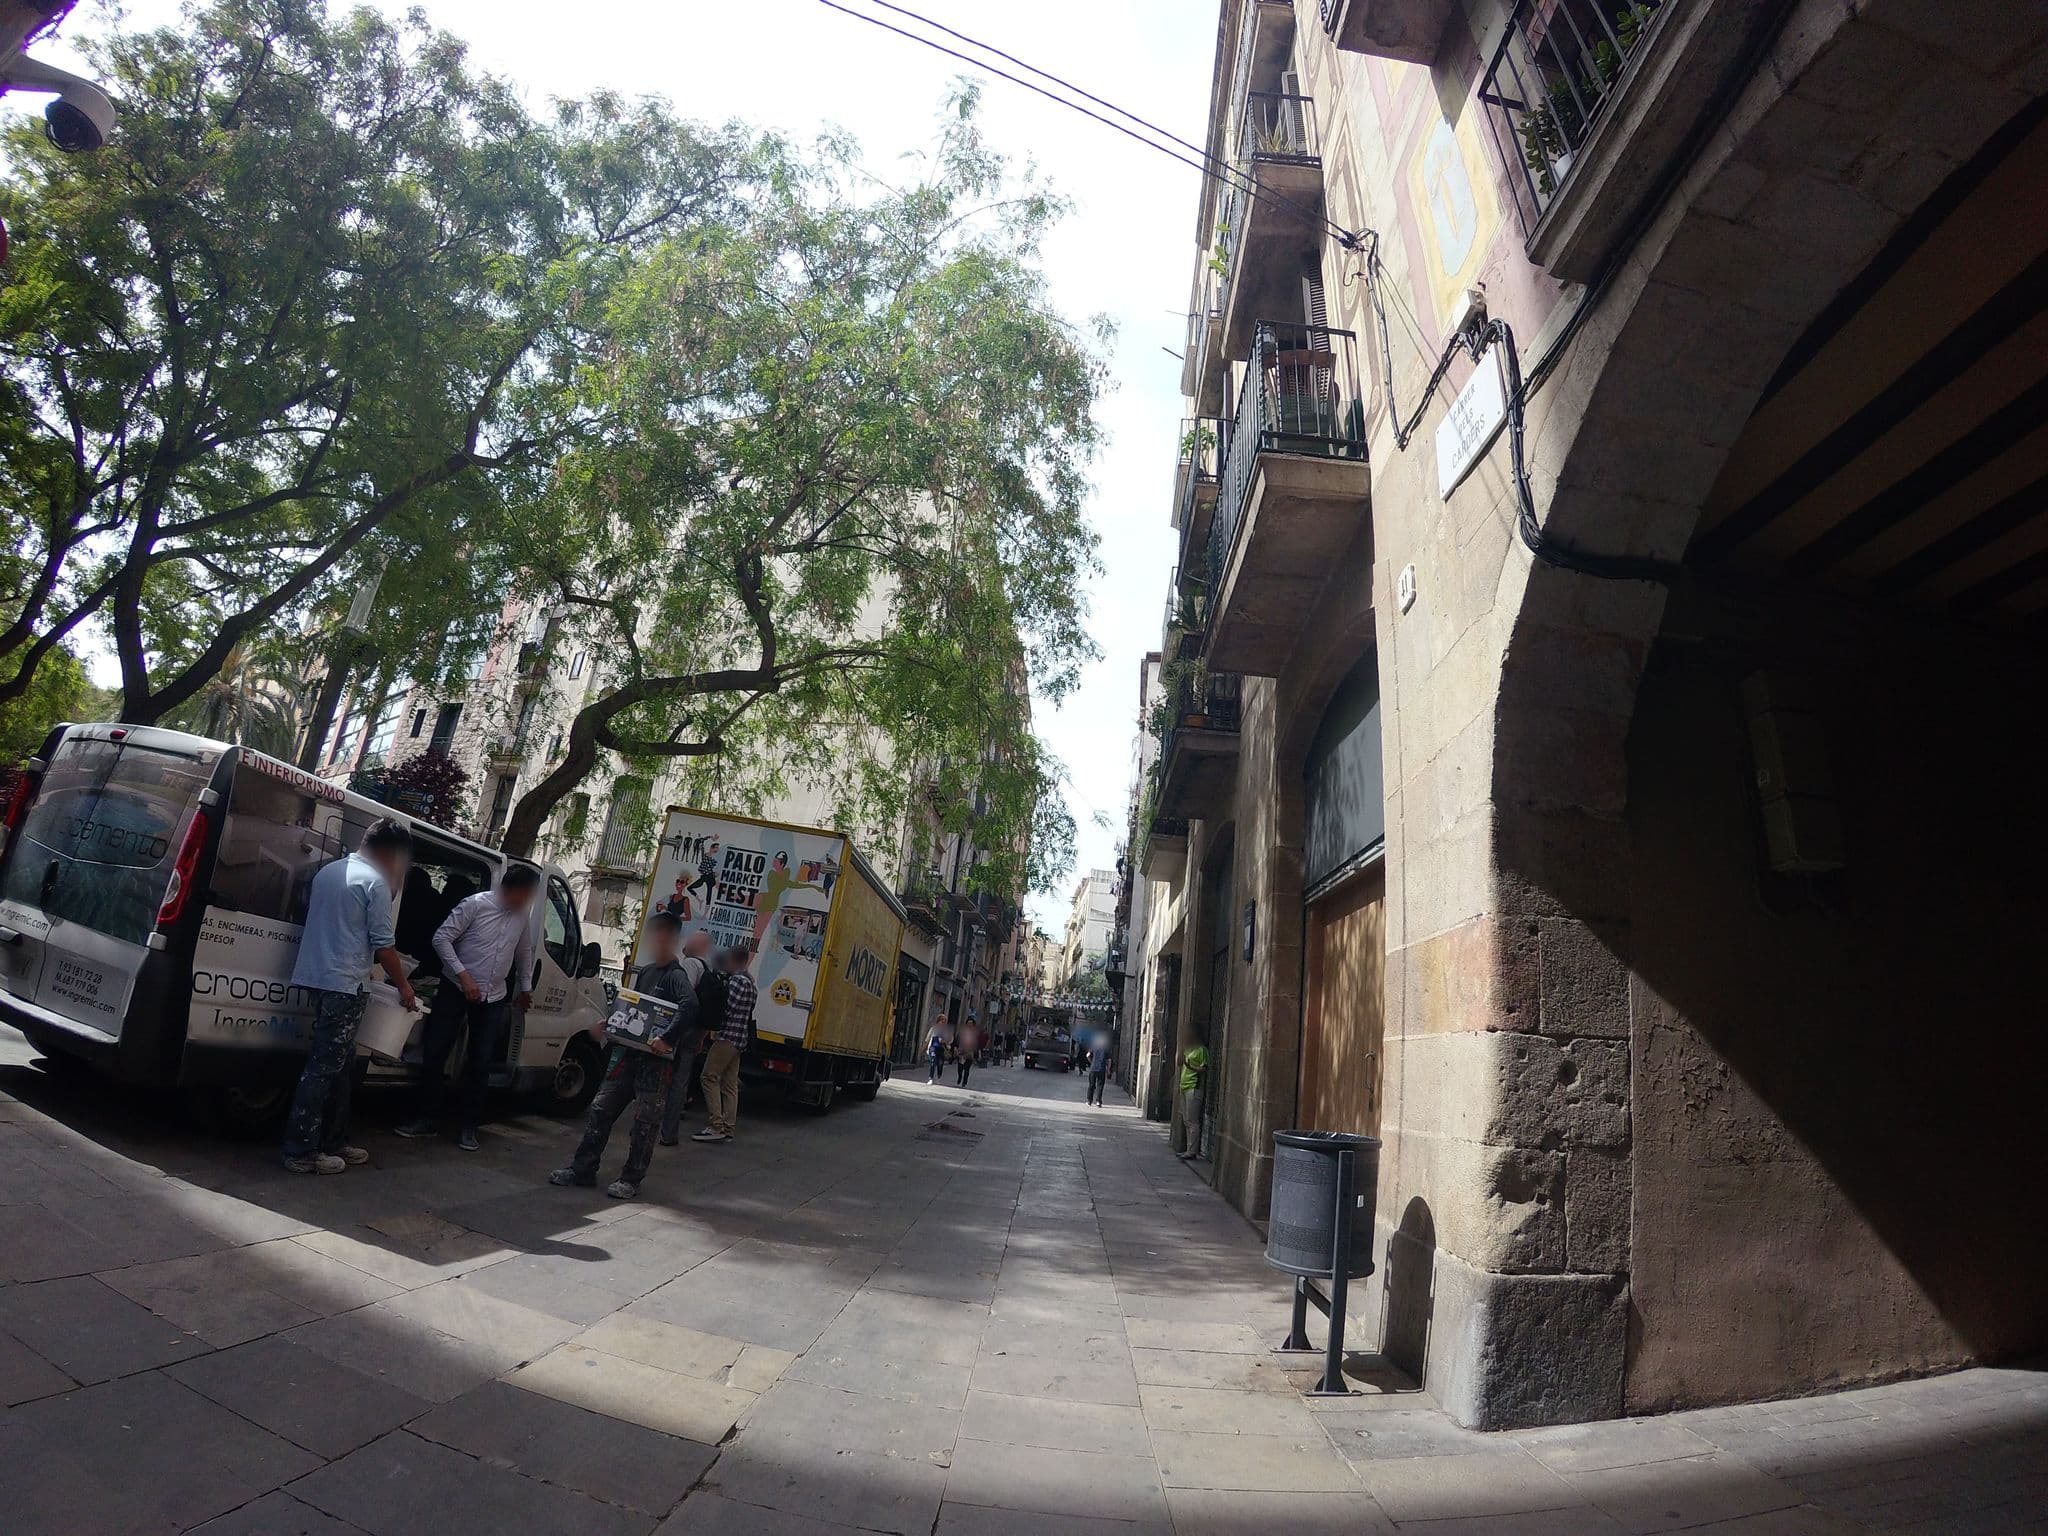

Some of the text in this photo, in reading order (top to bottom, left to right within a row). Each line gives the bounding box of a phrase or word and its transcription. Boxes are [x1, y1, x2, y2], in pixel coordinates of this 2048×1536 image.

[1453, 383, 1476, 423] CARRER
[1458, 407, 1474, 434] DELS
[1452, 413, 1486, 469] CARDERS
[242, 751, 346, 803] E INTERIORISMO
[723, 850, 766, 874] PALO
[720, 869, 763, 888] MARKET
[716, 882, 760, 907] FEST
[709, 907, 731, 925] FABRA
[735, 911, 758, 929] COATS
[199, 931, 236, 946] ESPESOR
[844, 944, 888, 998] MORITZ
